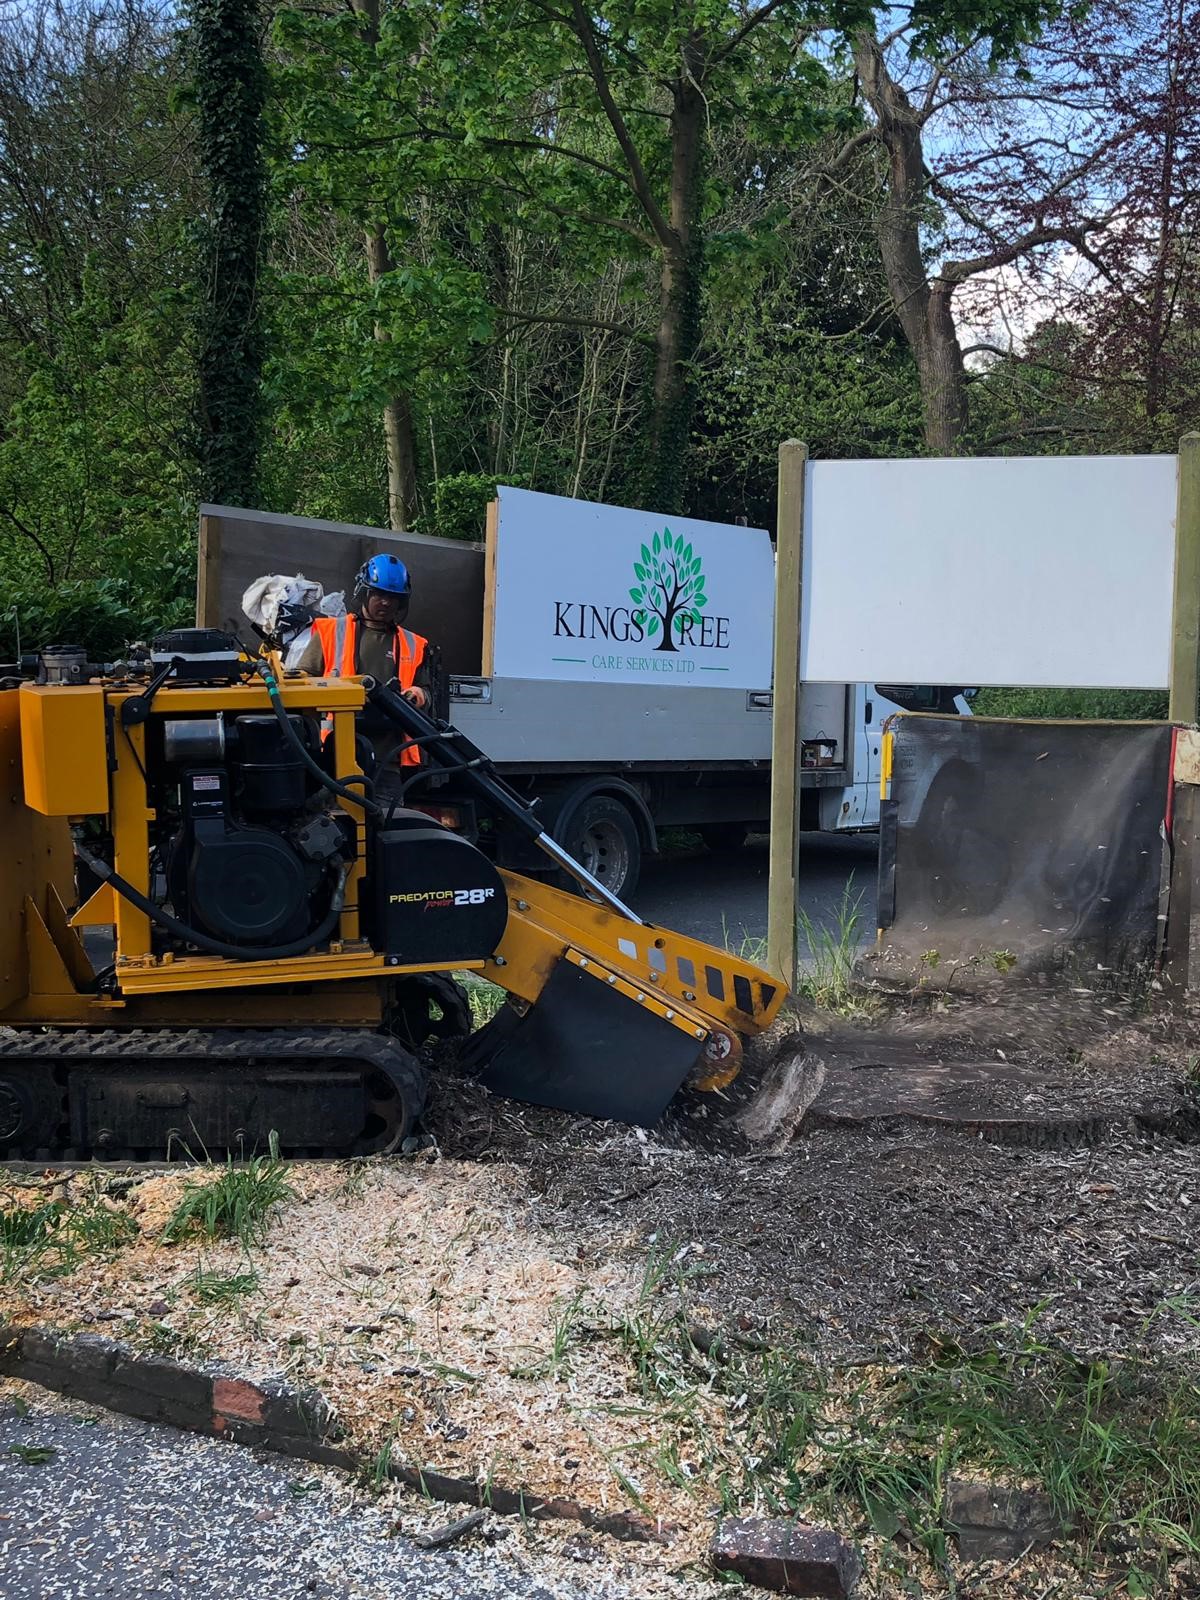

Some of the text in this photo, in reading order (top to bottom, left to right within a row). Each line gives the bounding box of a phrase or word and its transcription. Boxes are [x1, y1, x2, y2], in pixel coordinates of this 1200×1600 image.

[592, 654, 695, 673] CARE SERVICES LTD
[389, 890, 454, 904] PREDATOR
